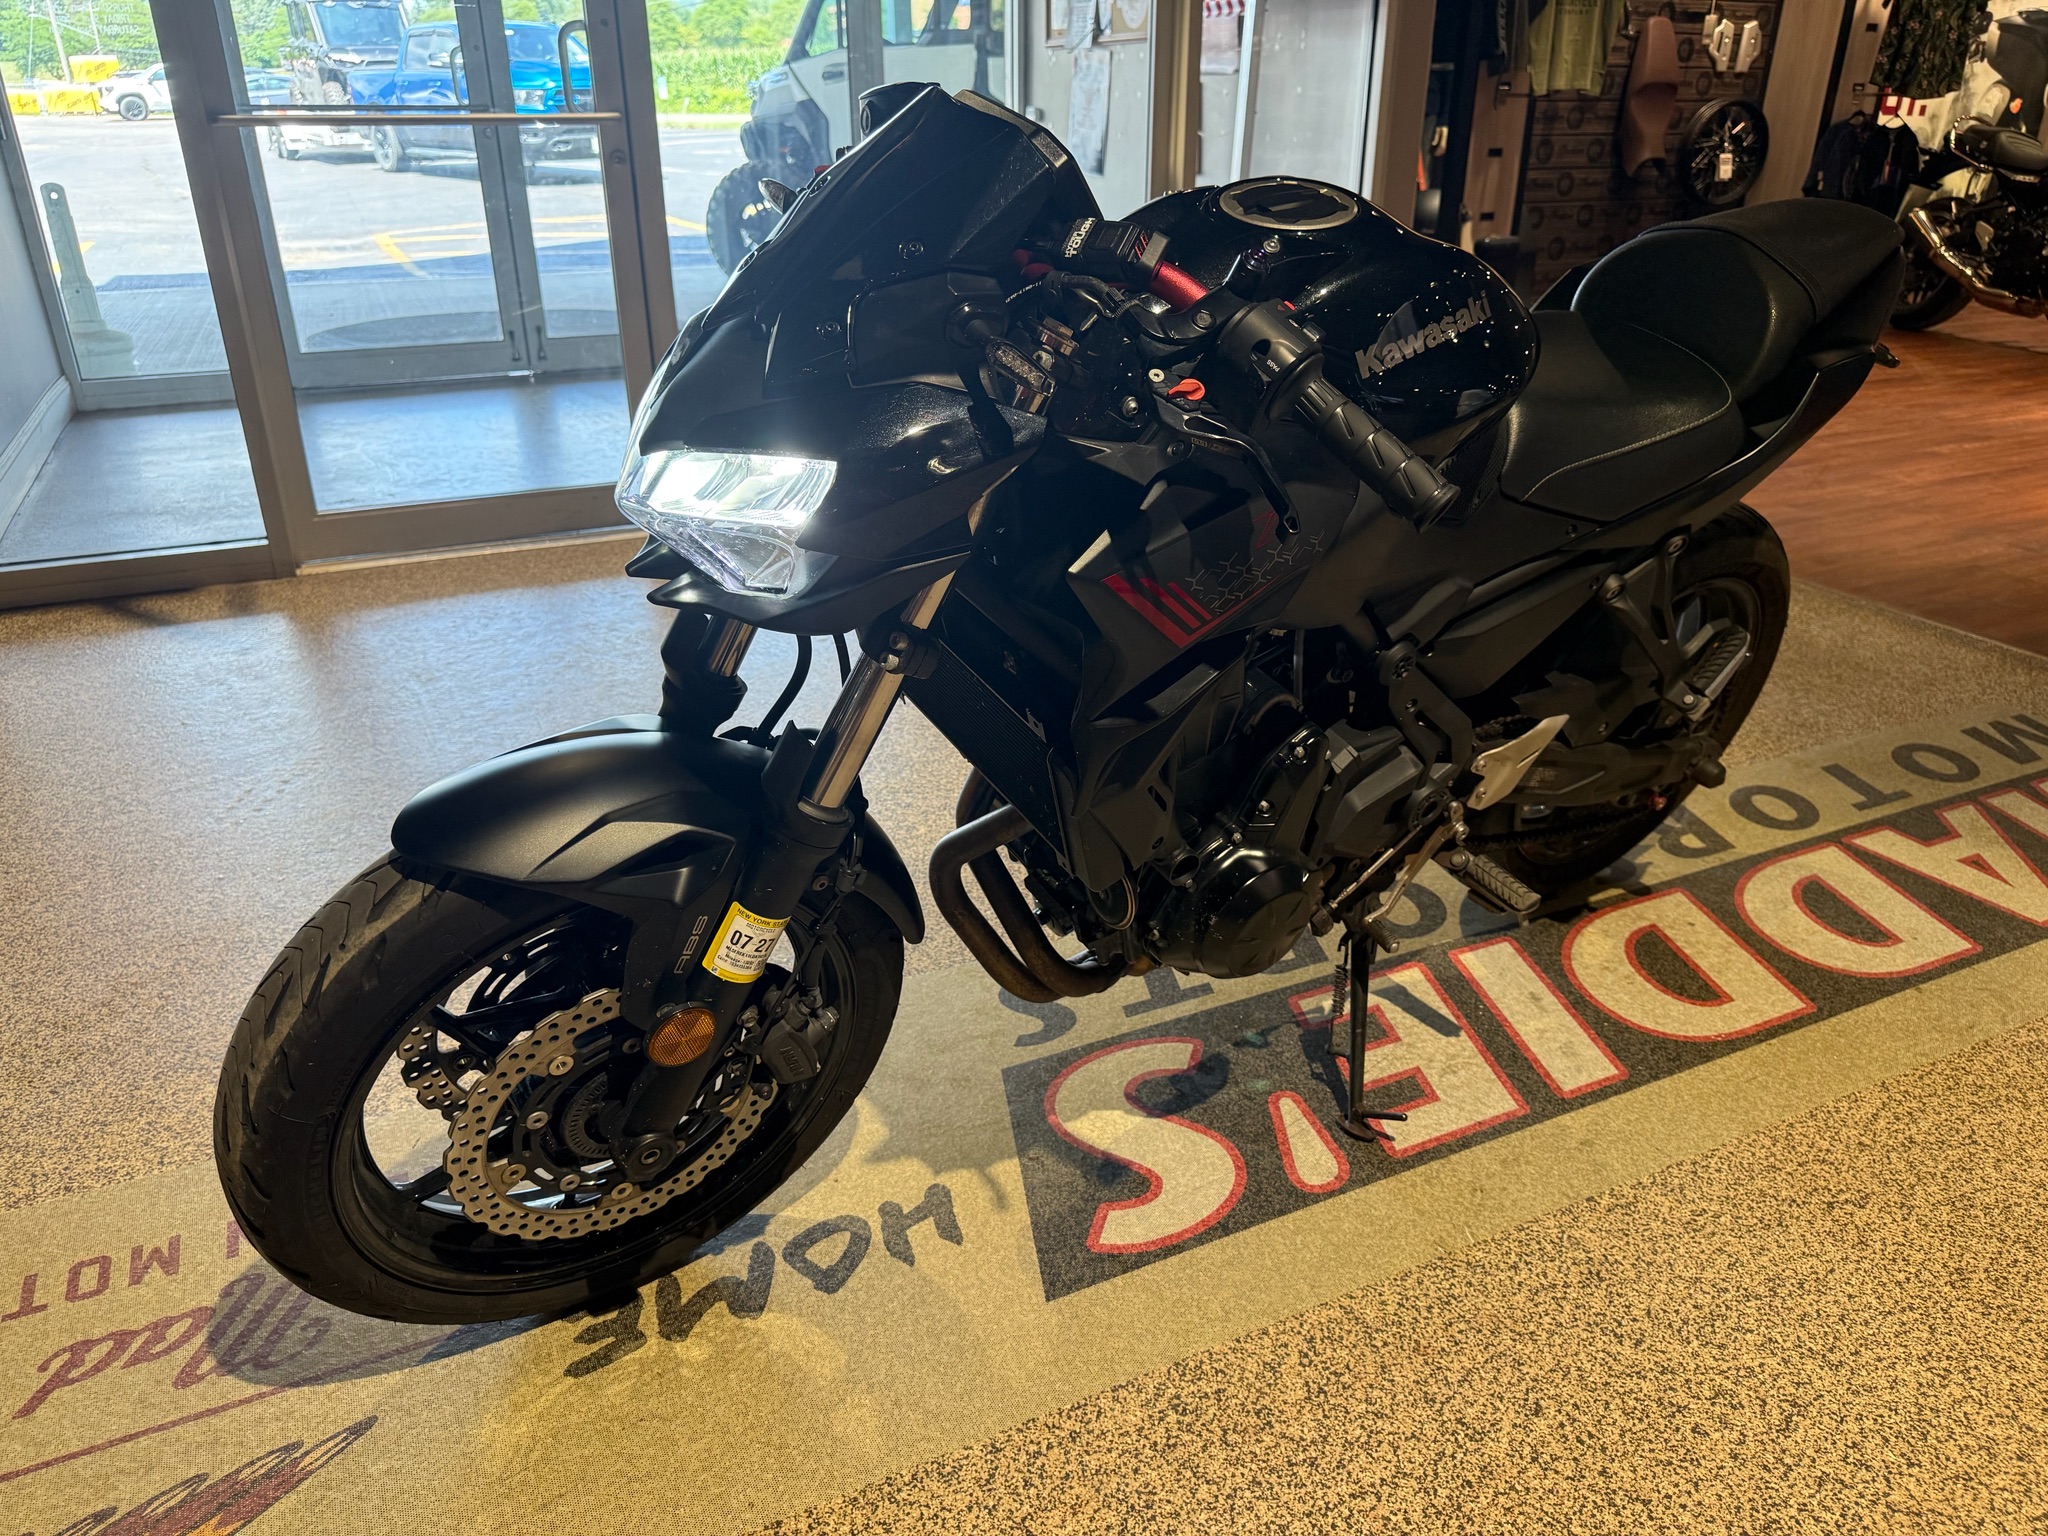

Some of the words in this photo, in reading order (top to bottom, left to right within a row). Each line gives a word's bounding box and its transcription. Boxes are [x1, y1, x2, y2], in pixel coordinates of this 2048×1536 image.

[1069, 217, 1096, 257] TOUGH
[1266, 359, 1281, 373] PASS
[1354, 289, 1492, 380] Kawasaki
[673, 915, 708, 974] ABS
[730, 929, 754, 950] 07
[754, 937, 776, 953] 27
[737, 907, 752, 920] NEW
[753, 917, 771, 927] YORK
[1044, 779, 2048, 1255] ADDIE'S
[0, 1234, 182, 1323] MOT
[563, 1183, 964, 1378] HOME
[12, 1272, 332, 1420] Mad
